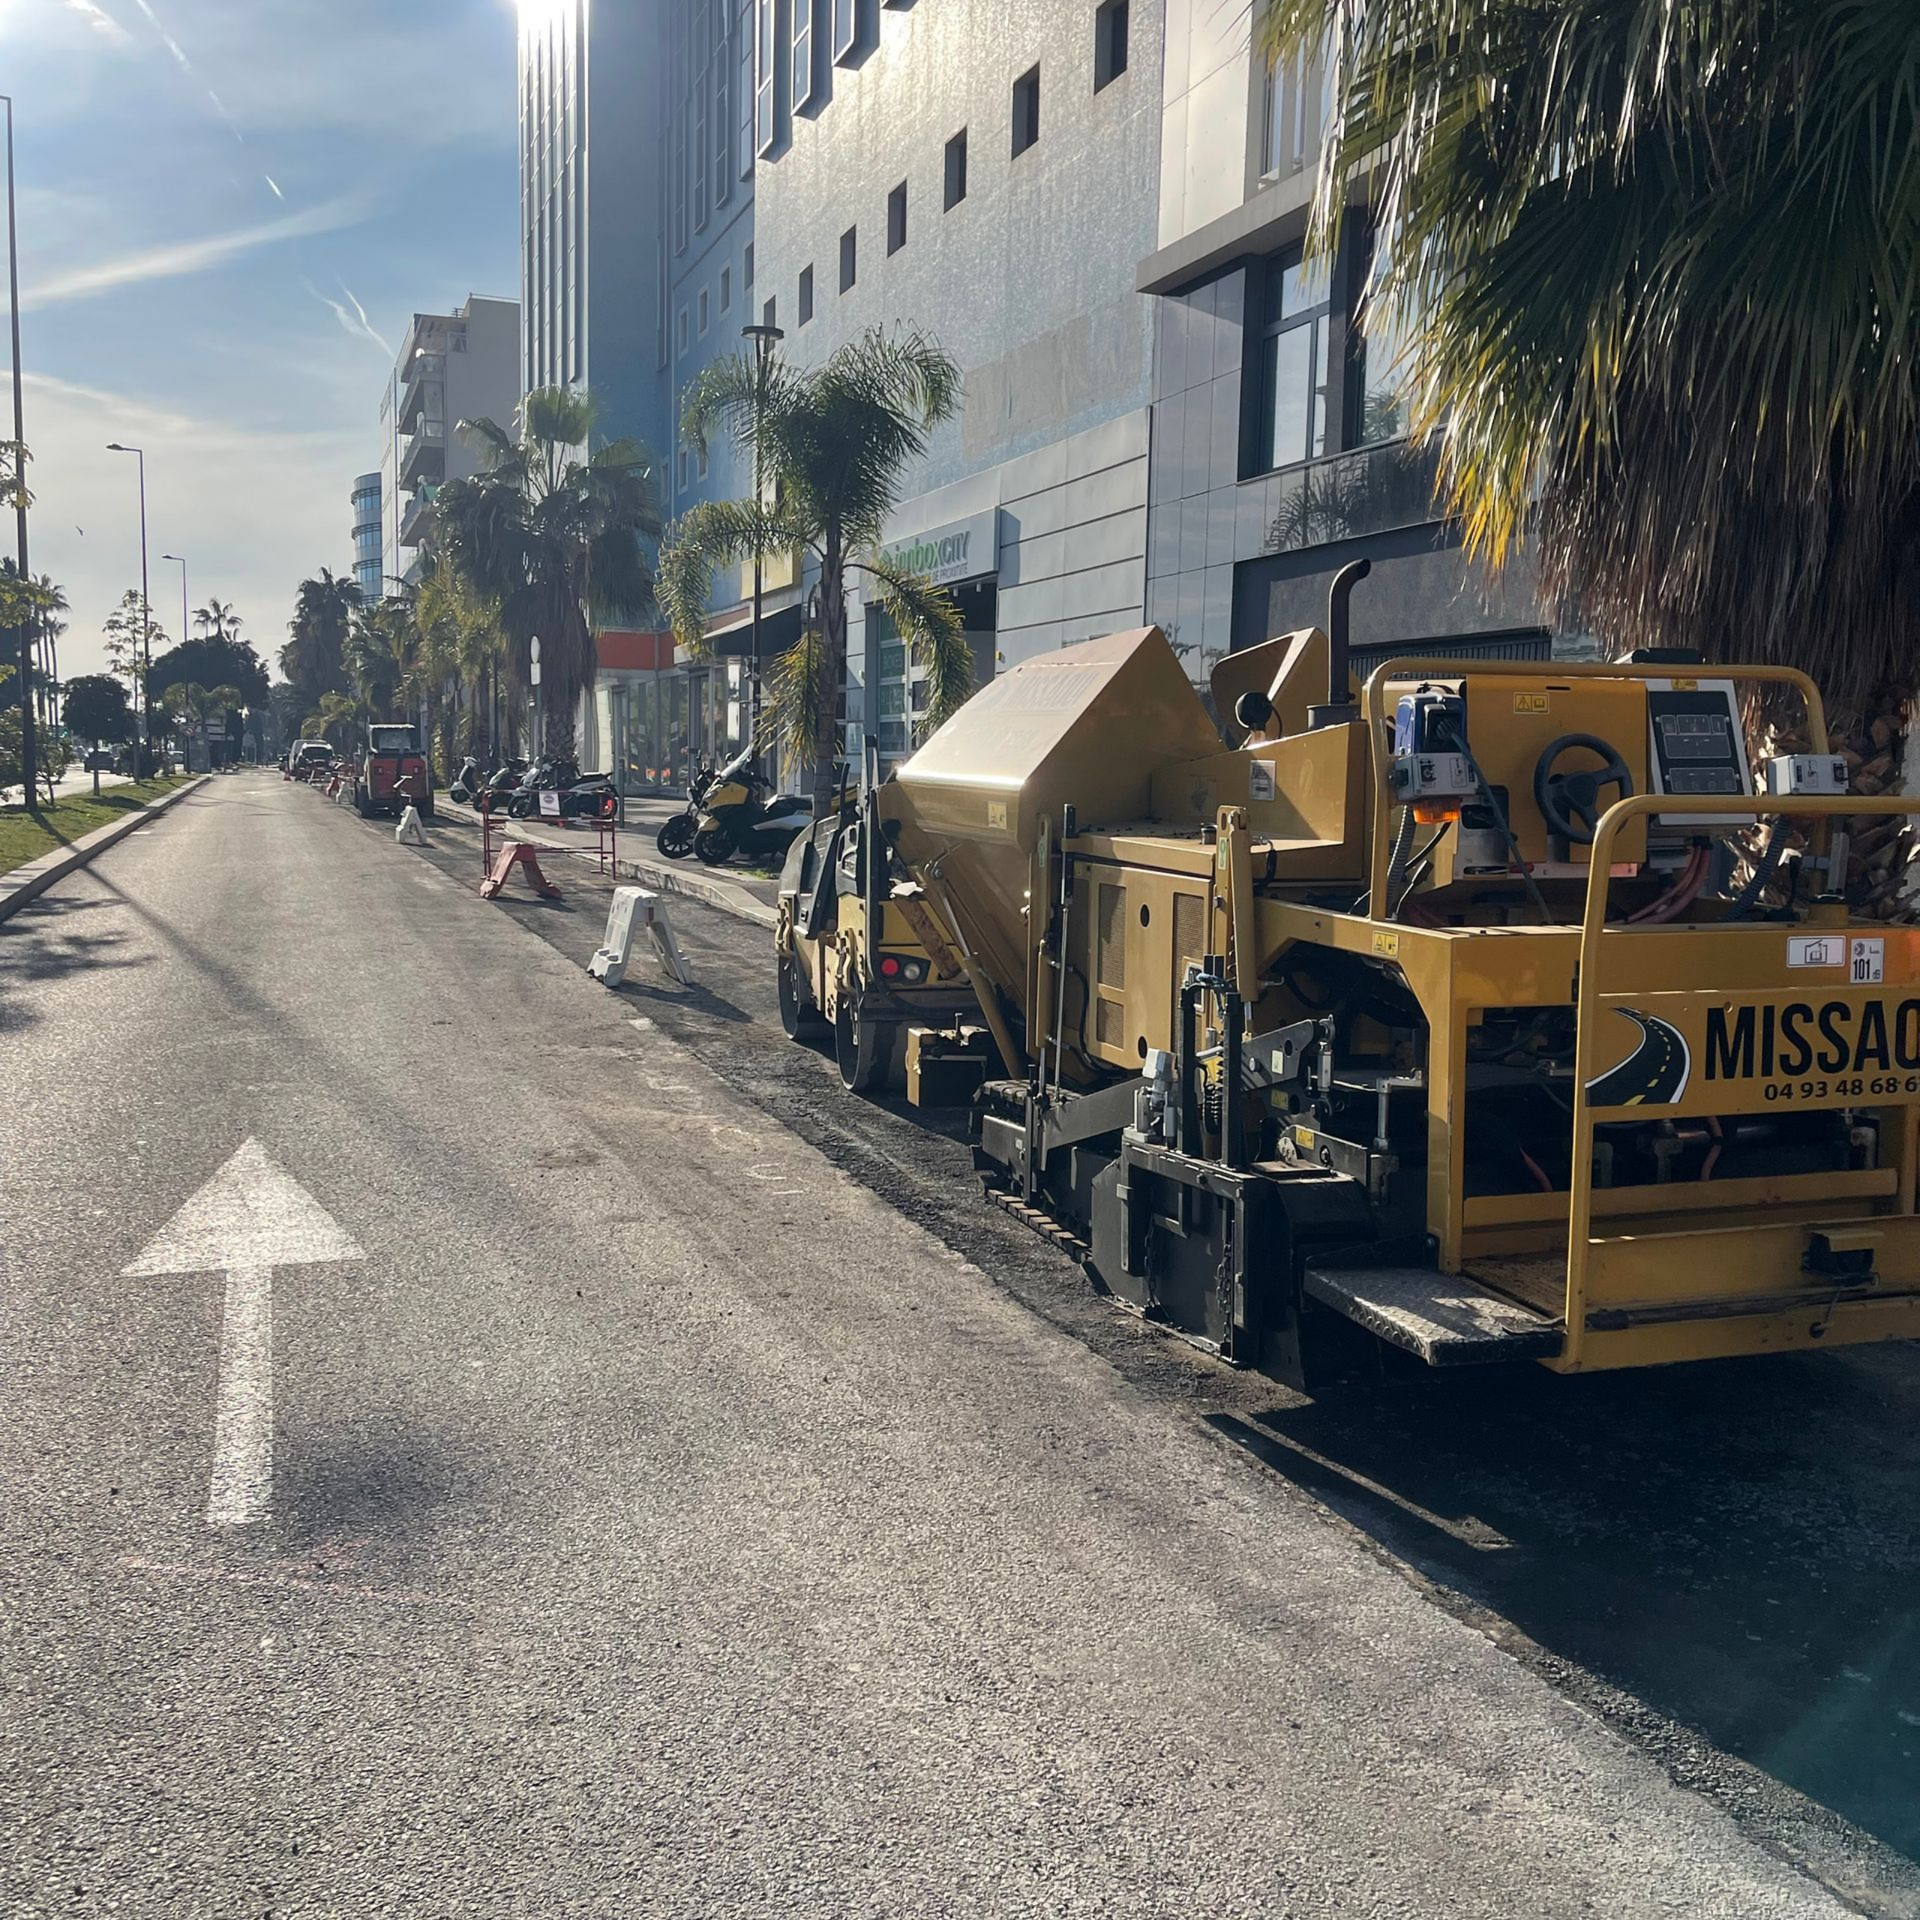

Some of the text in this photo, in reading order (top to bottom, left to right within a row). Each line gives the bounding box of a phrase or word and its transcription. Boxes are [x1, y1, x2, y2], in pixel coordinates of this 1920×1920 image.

[1853, 958, 1870, 980] 101
[1764, 1075, 1920, 1101] 04 93 48 68 6
